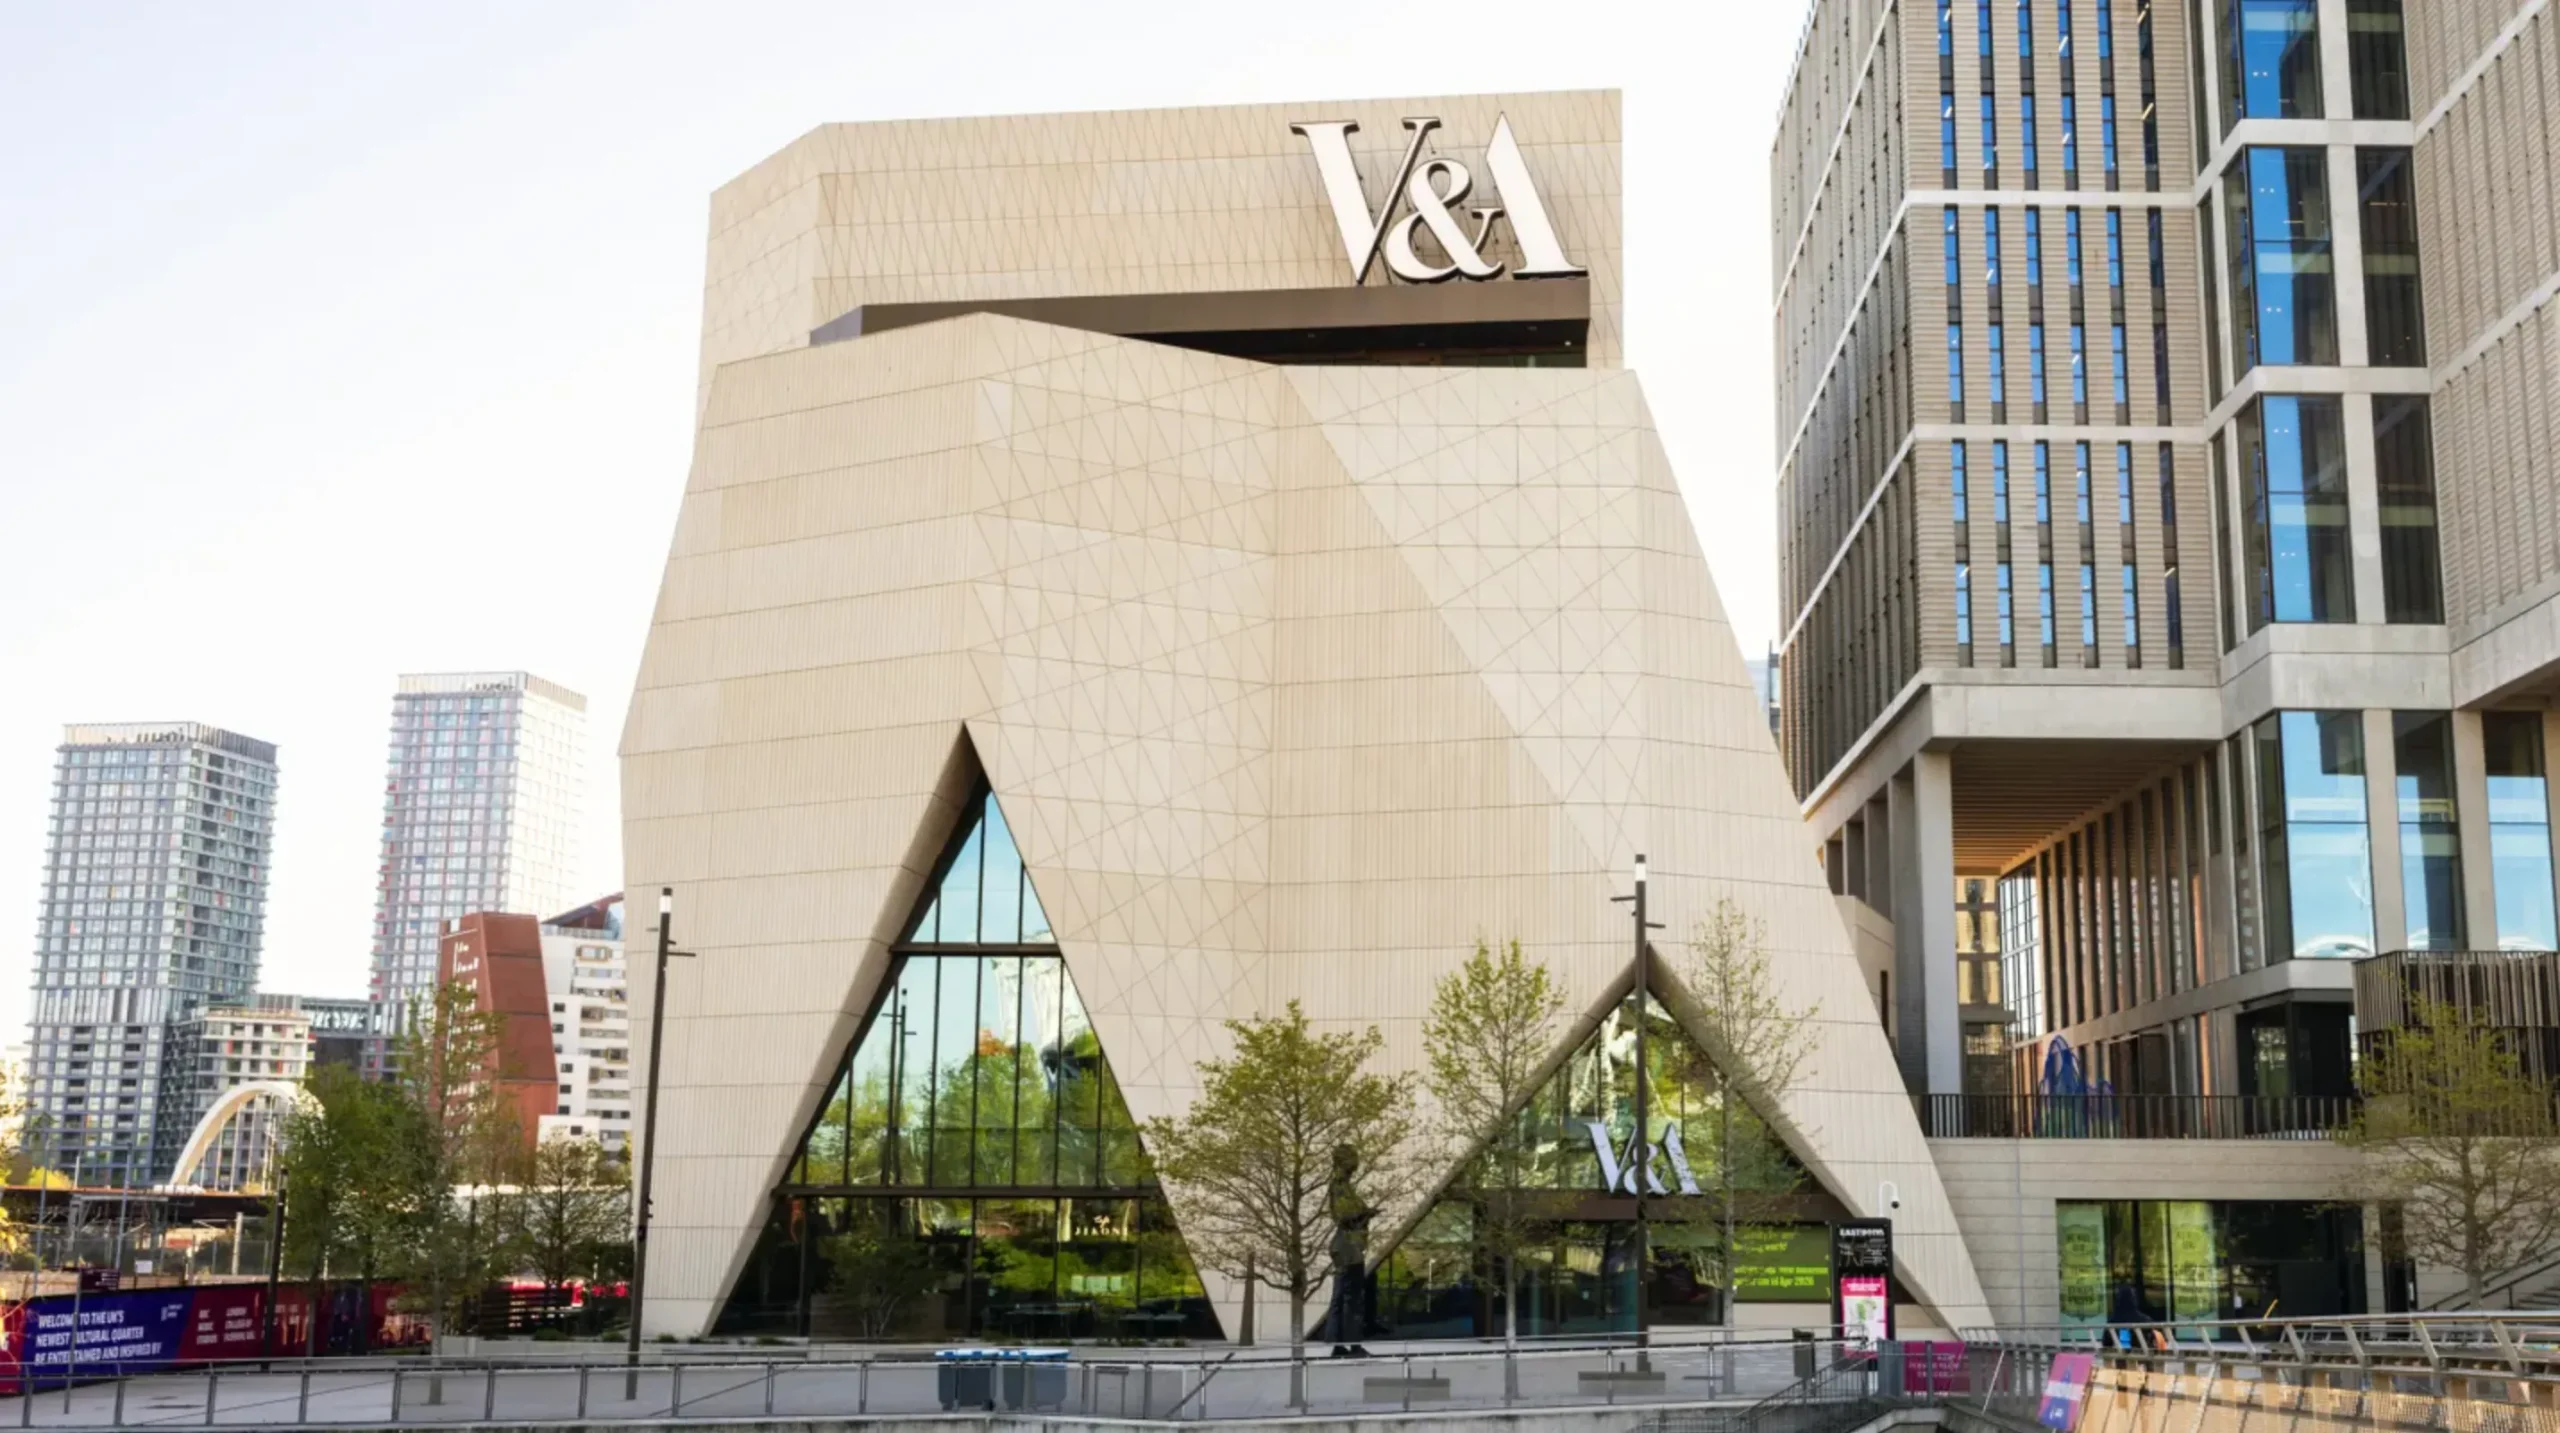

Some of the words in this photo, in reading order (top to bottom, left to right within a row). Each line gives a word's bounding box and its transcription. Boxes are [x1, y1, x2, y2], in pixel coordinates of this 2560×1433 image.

[1289, 111, 1588, 286] V&A
[1584, 1121, 1704, 1196] V&A
[38, 1314, 77, 1329] WELCOM
[79, 1312, 90, 1325] TO
[91, 1311, 106, 1325] THE
[107, 1309, 125, 1324] UK'S
[35, 1331, 71, 1348] NEWEST
[74, 1328, 110, 1345] ULTURAL
[110, 1326, 144, 1342] QUARTER
[101, 1345, 119, 1360] AND
[151, 1341, 162, 1355] BY
